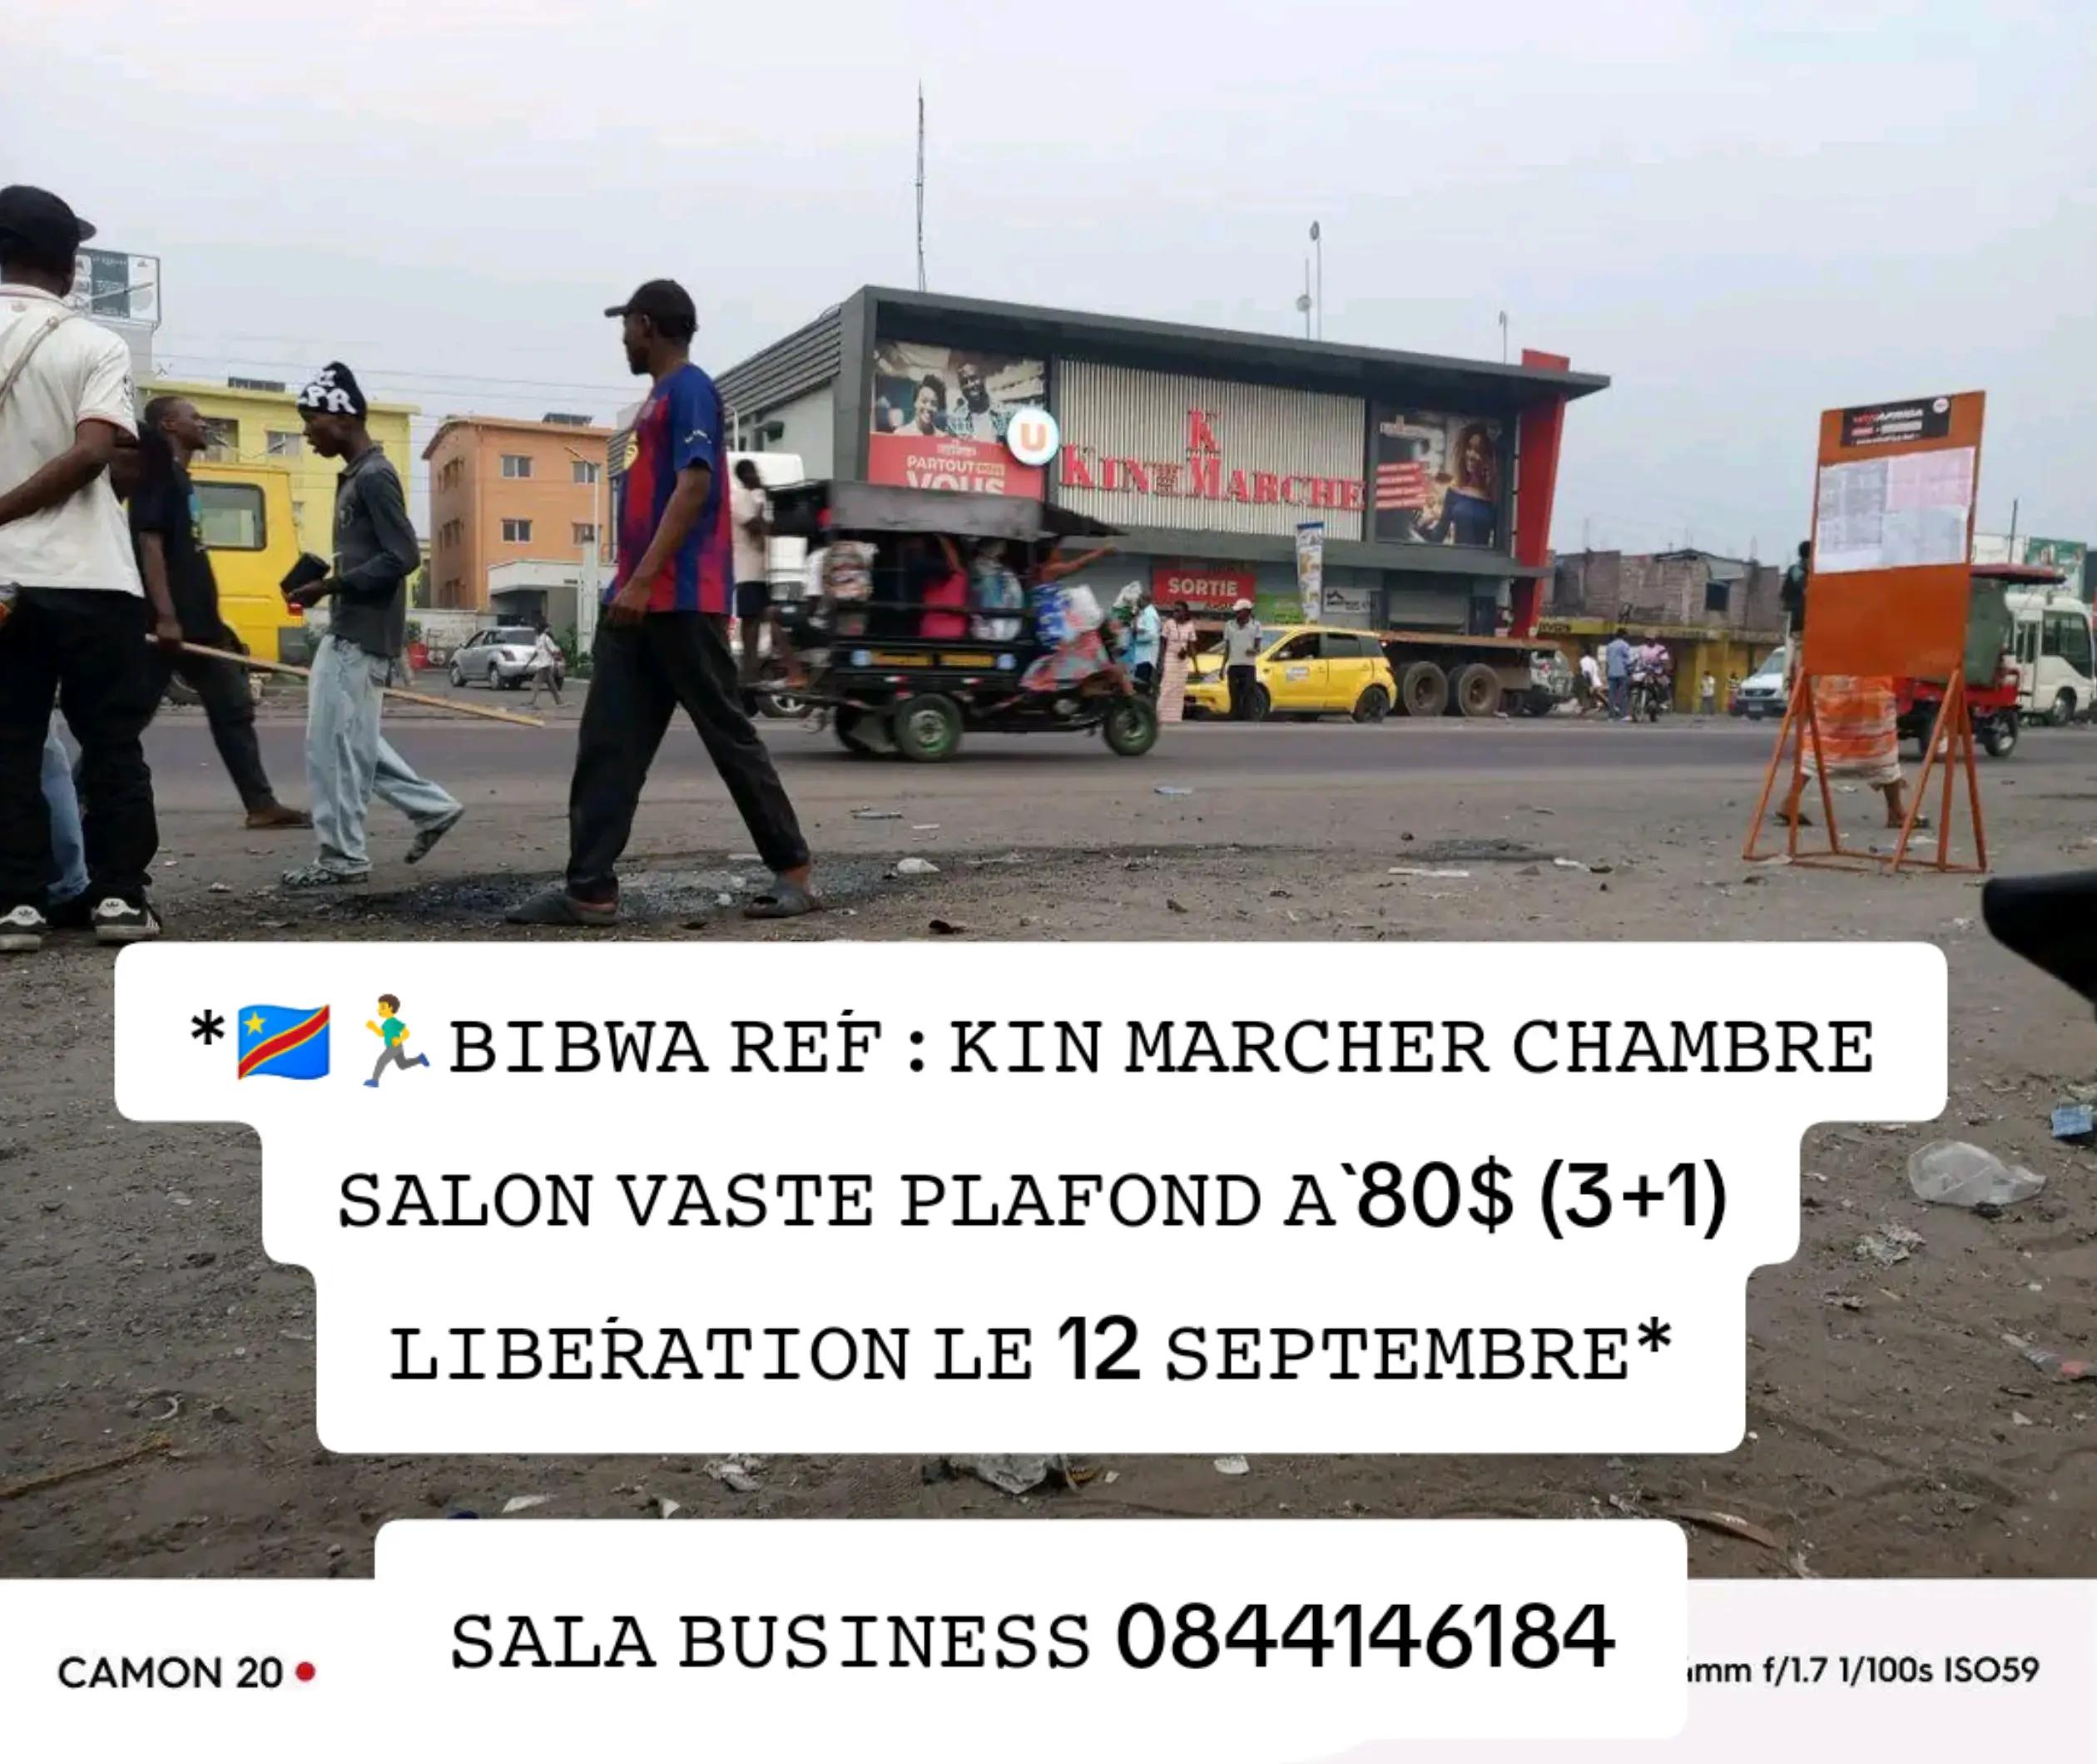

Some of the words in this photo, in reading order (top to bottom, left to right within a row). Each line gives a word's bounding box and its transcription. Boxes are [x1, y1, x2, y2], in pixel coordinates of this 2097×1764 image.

[1020, 423, 1047, 452] U
[1187, 409, 1221, 453] K
[906, 455, 977, 473] PARTOUT
[1059, 443, 1153, 494] KIN
[1187, 456, 1366, 511] MARCHE
[1167, 577, 1239, 597] SORTIE
